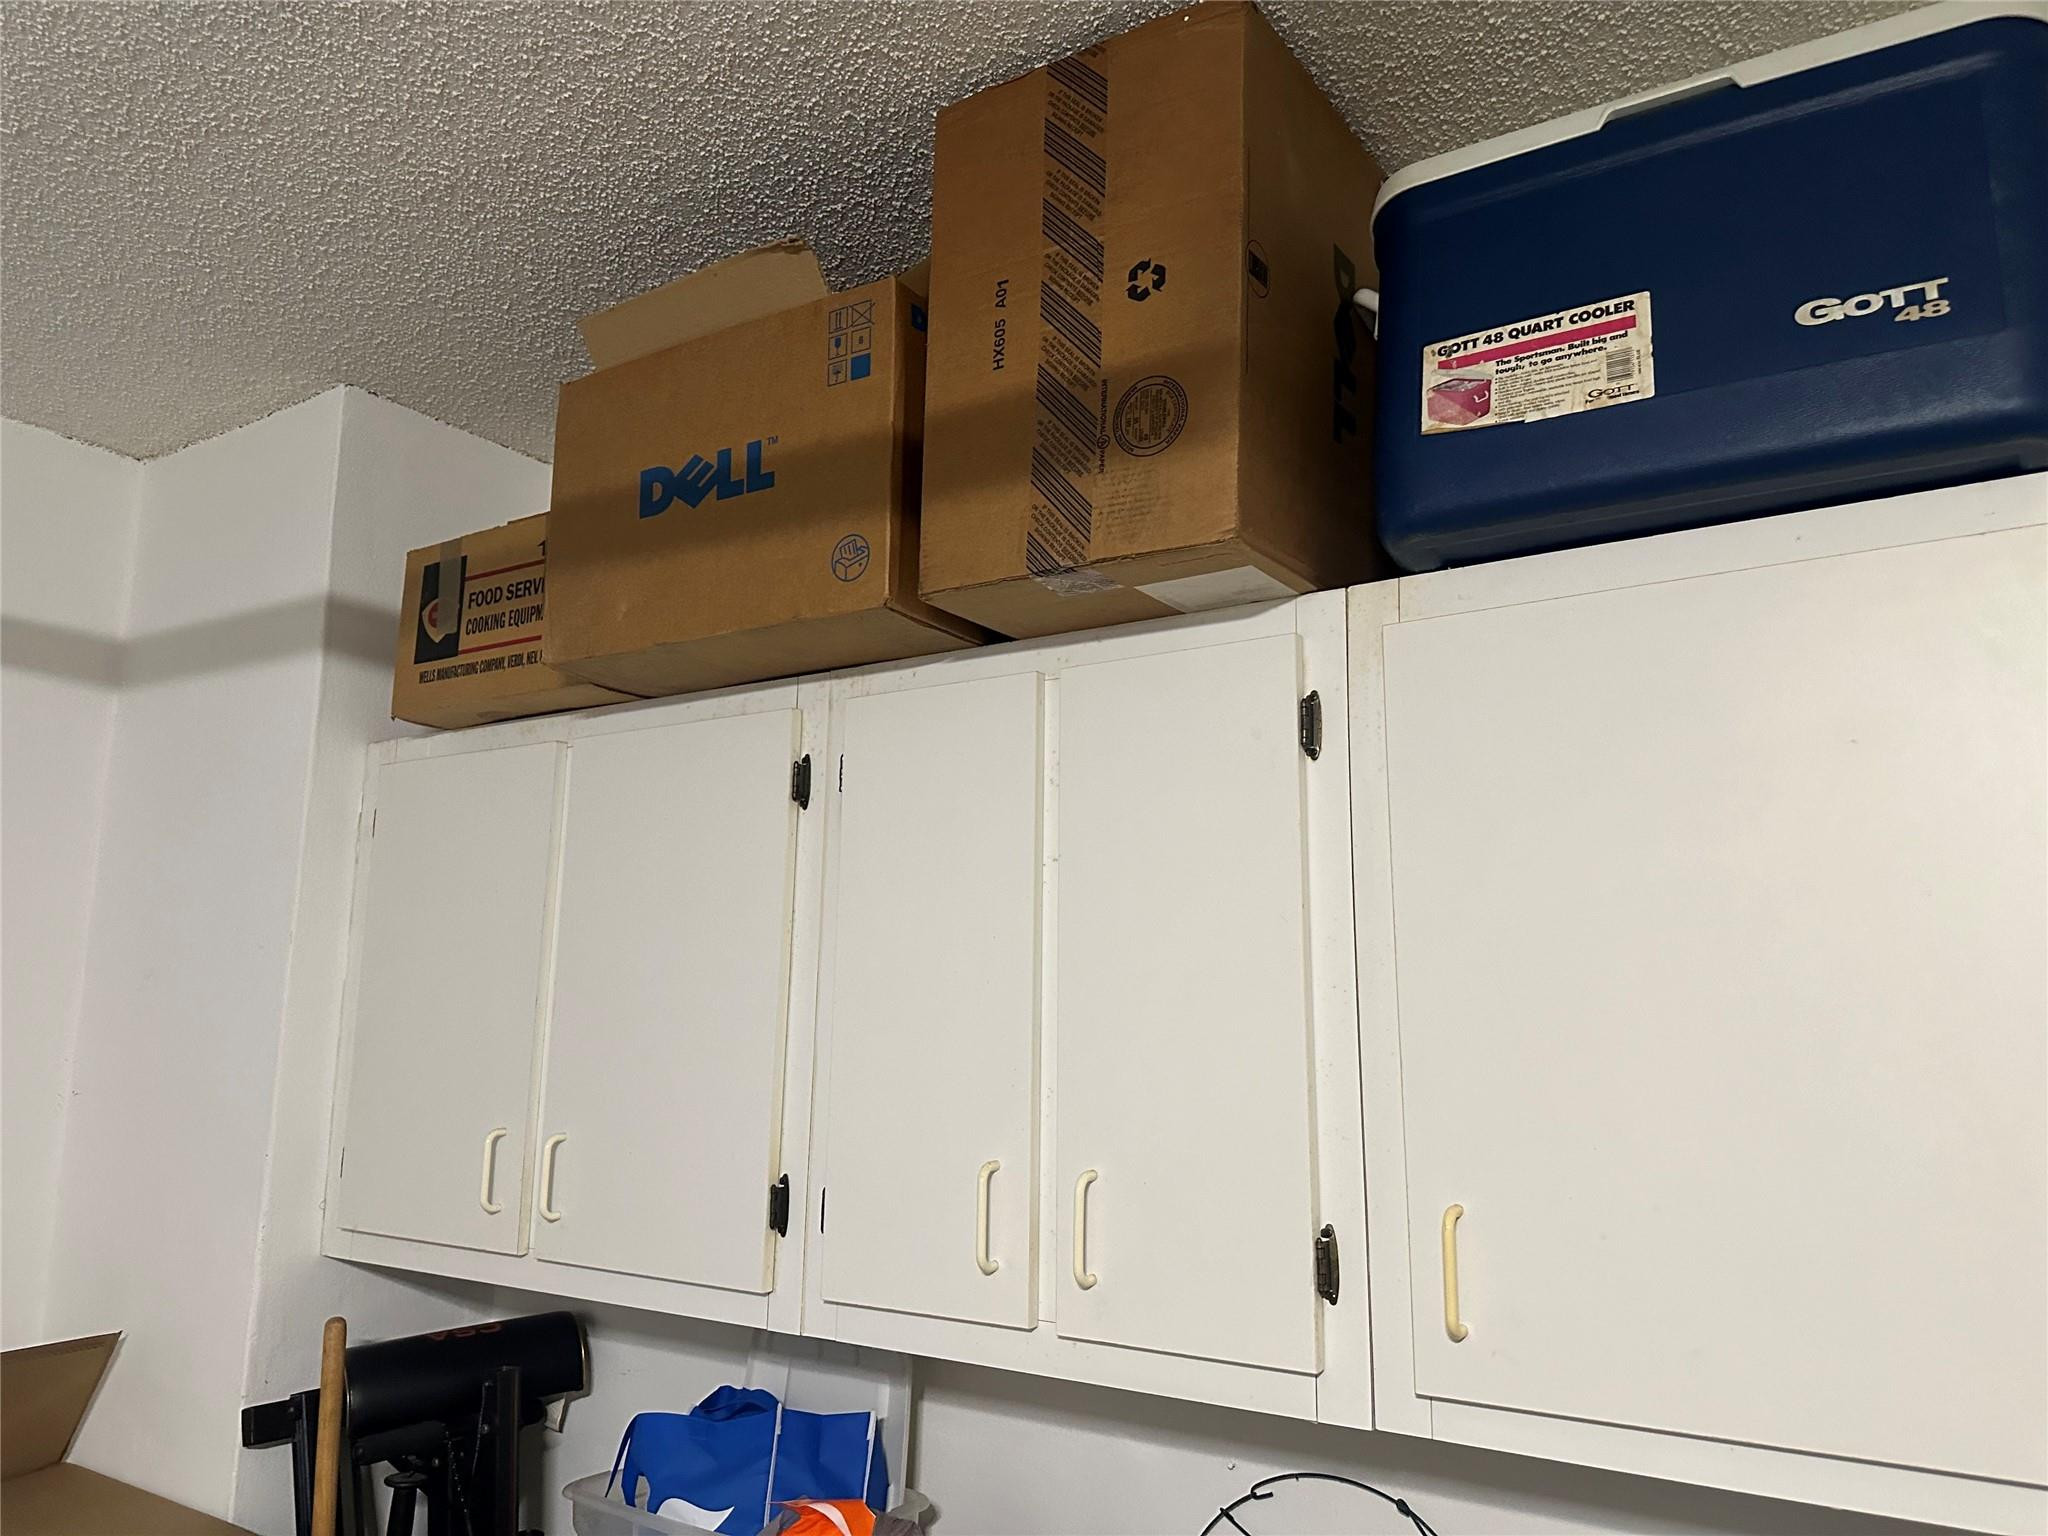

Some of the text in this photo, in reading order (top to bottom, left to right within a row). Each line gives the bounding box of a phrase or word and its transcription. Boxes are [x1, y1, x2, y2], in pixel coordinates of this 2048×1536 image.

[1793, 276, 1949, 326] GOTT
[1893, 299, 1951, 322] 48
[992, 279, 1009, 371] HX605 A01
[1437, 299, 1635, 358] GOTT 48 QUART COOLER
[1495, 330, 1629, 367] The Sportsman. Built big and
[1495, 345, 1607, 375] tough, to go anywhere.
[1588, 384, 1637, 398] GOTT
[639, 439, 776, 520] DELL
[467, 586, 503, 610] FOOD
[465, 612, 506, 635] COOKING
[436, 660, 480, 681] MANUFACTURING
